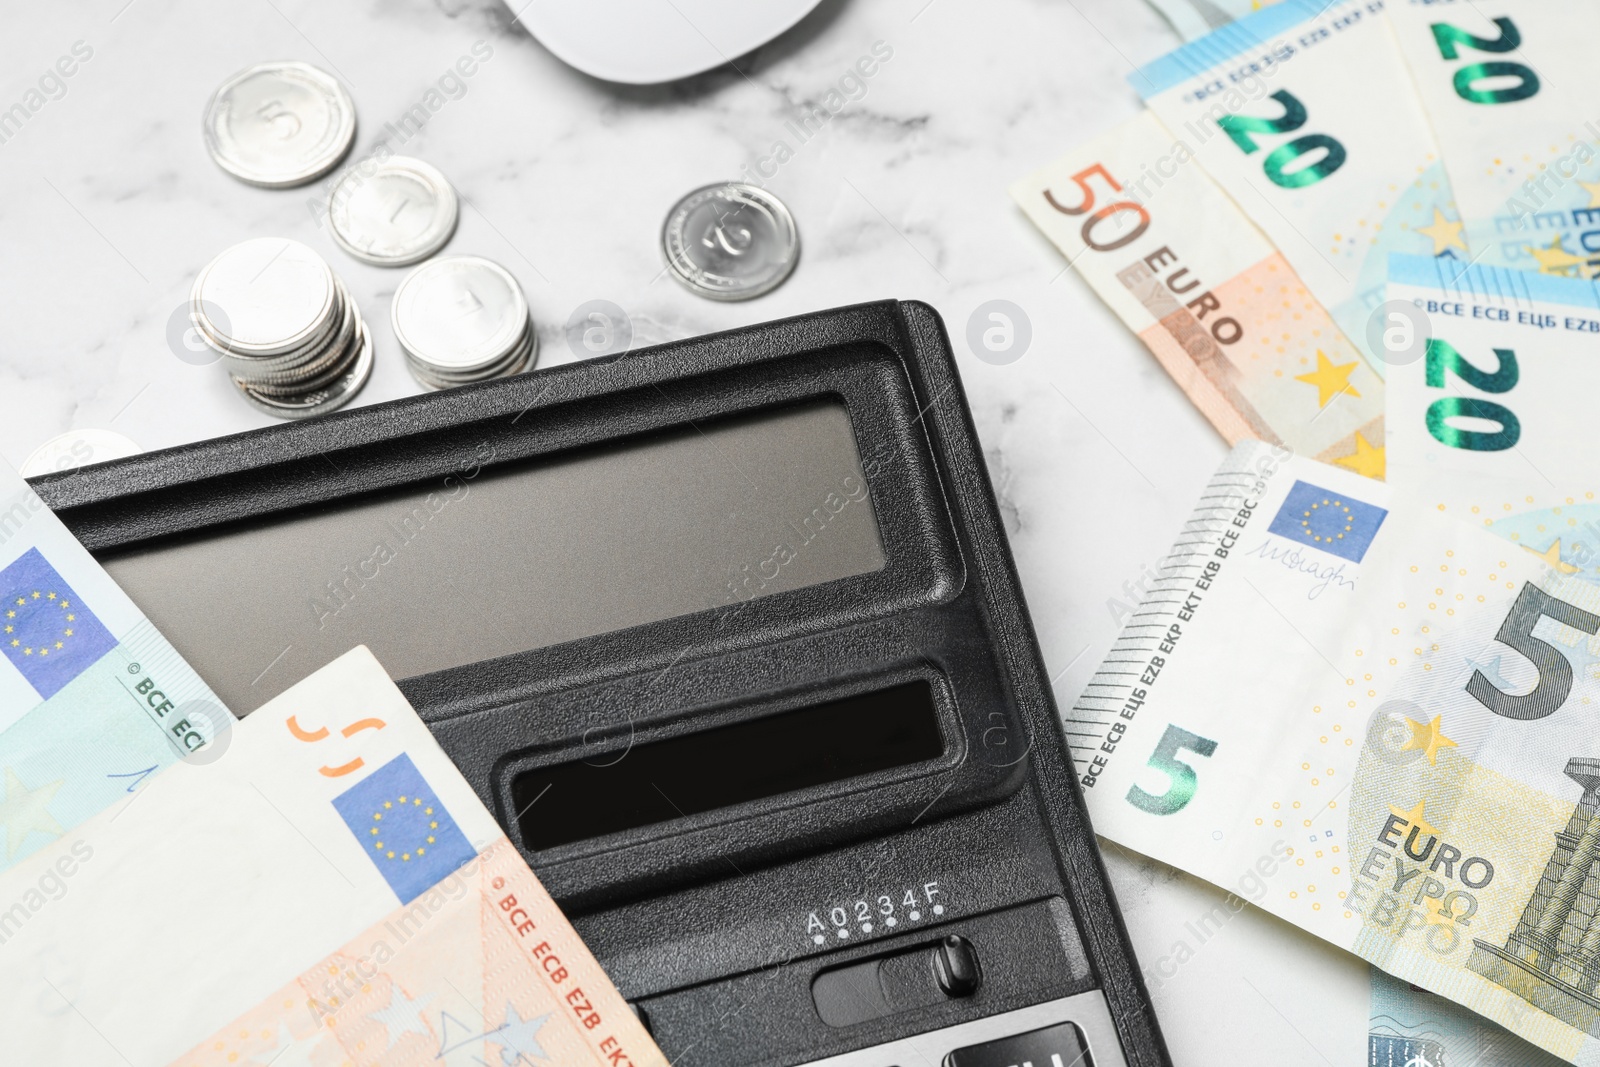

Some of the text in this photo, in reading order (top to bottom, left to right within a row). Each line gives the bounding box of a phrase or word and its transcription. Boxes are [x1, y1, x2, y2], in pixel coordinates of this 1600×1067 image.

[1430, 16, 1541, 105] 20
[1216, 88, 1347, 190] 20
[1042, 161, 1151, 252] 50
[1143, 245, 1243, 346] EURO
[1472, 305, 1510, 322] ECB
[1425, 337, 1522, 452] 20
[1100, 722, 1128, 755] ECB
[1139, 655, 1167, 687] EZB
[1158, 623, 1184, 655] EKP
[1176, 591, 1203, 622] EKT
[1195, 560, 1222, 591] EKB
[1231, 498, 1259, 529] EBC
[1464, 579, 1600, 721] 5
[134, 676, 175, 718] BCE
[1124, 722, 1219, 818] 5
[1376, 813, 1495, 890] EURO
[807, 911, 826, 934] A
[854, 901, 872, 922] 2
[877, 895, 894, 915] 3
[902, 889, 918, 908] 4
[923, 881, 940, 904] F
[498, 893, 537, 938] BCE
[532, 941, 570, 985] ECB
[565, 987, 602, 1031] EZB
